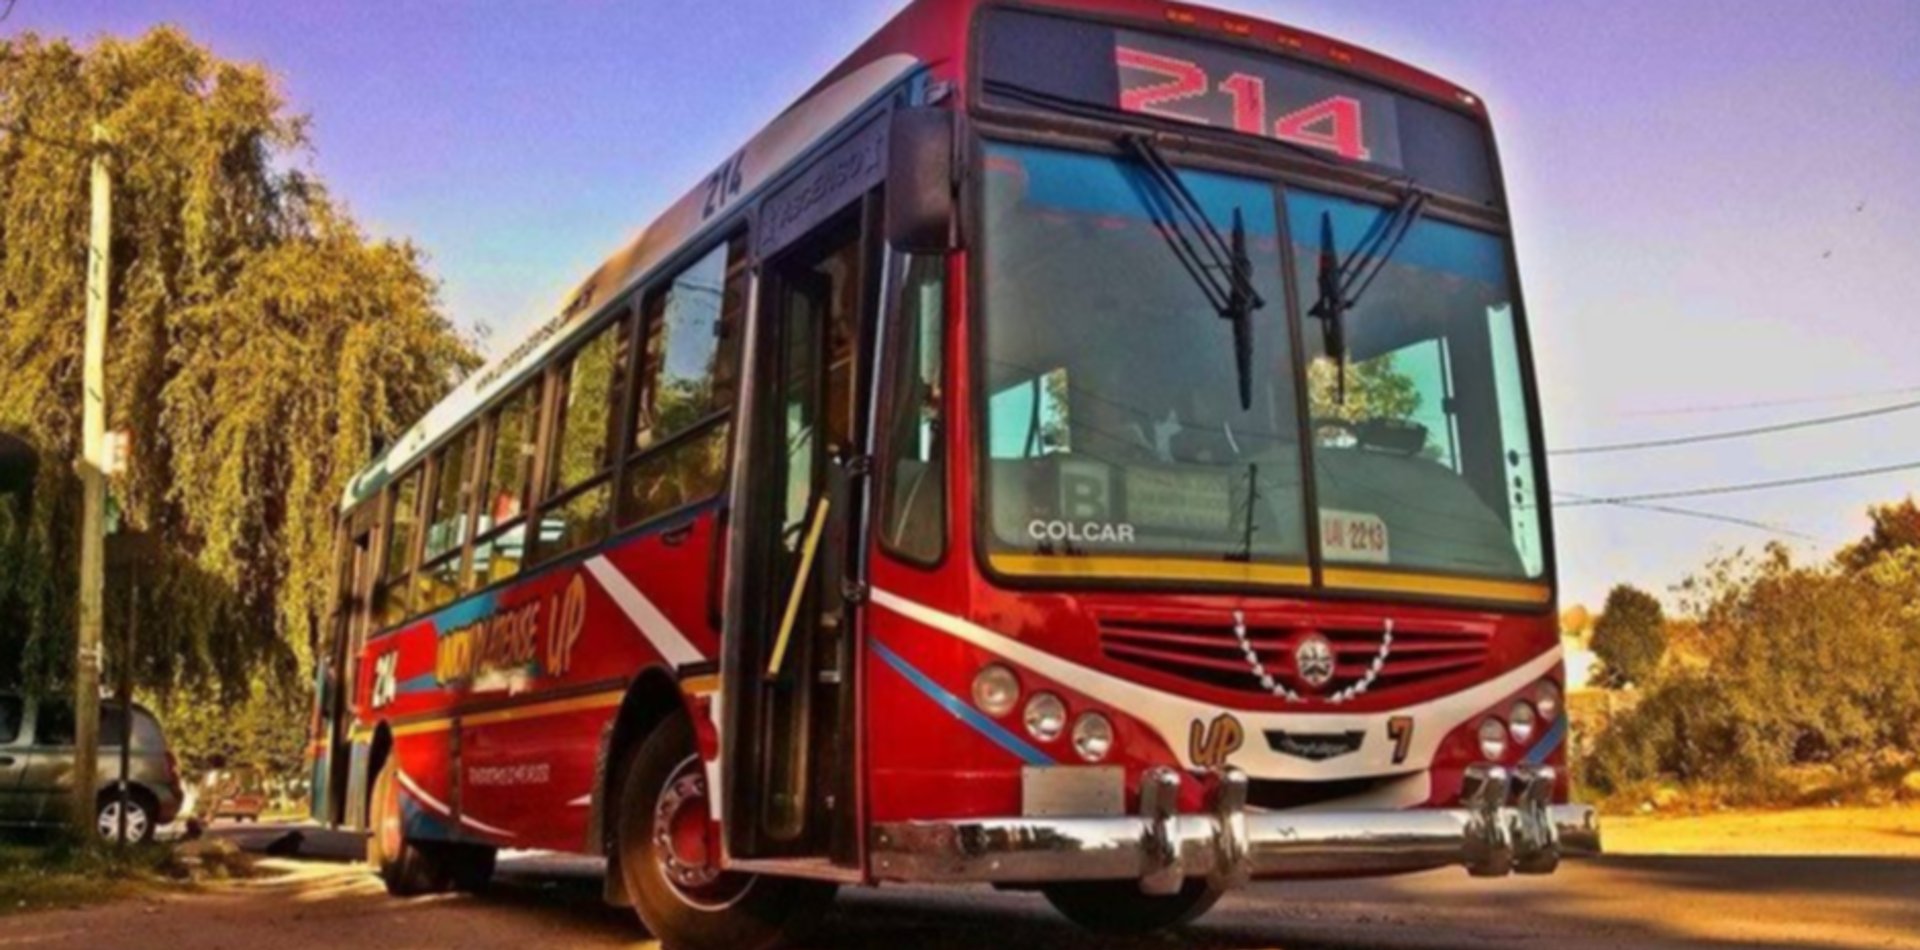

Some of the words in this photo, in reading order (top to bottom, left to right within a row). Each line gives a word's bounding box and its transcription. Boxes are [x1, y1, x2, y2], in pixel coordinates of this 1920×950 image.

[1115, 46, 1370, 162] 214
[702, 150, 746, 219] 214
[1064, 475, 1104, 520] B
[1027, 518, 1135, 544] COLCAR
[547, 571, 586, 678] UP
[371, 649, 399, 709] 214
[1189, 711, 1244, 768] UP
[1386, 715, 1414, 765] 7
